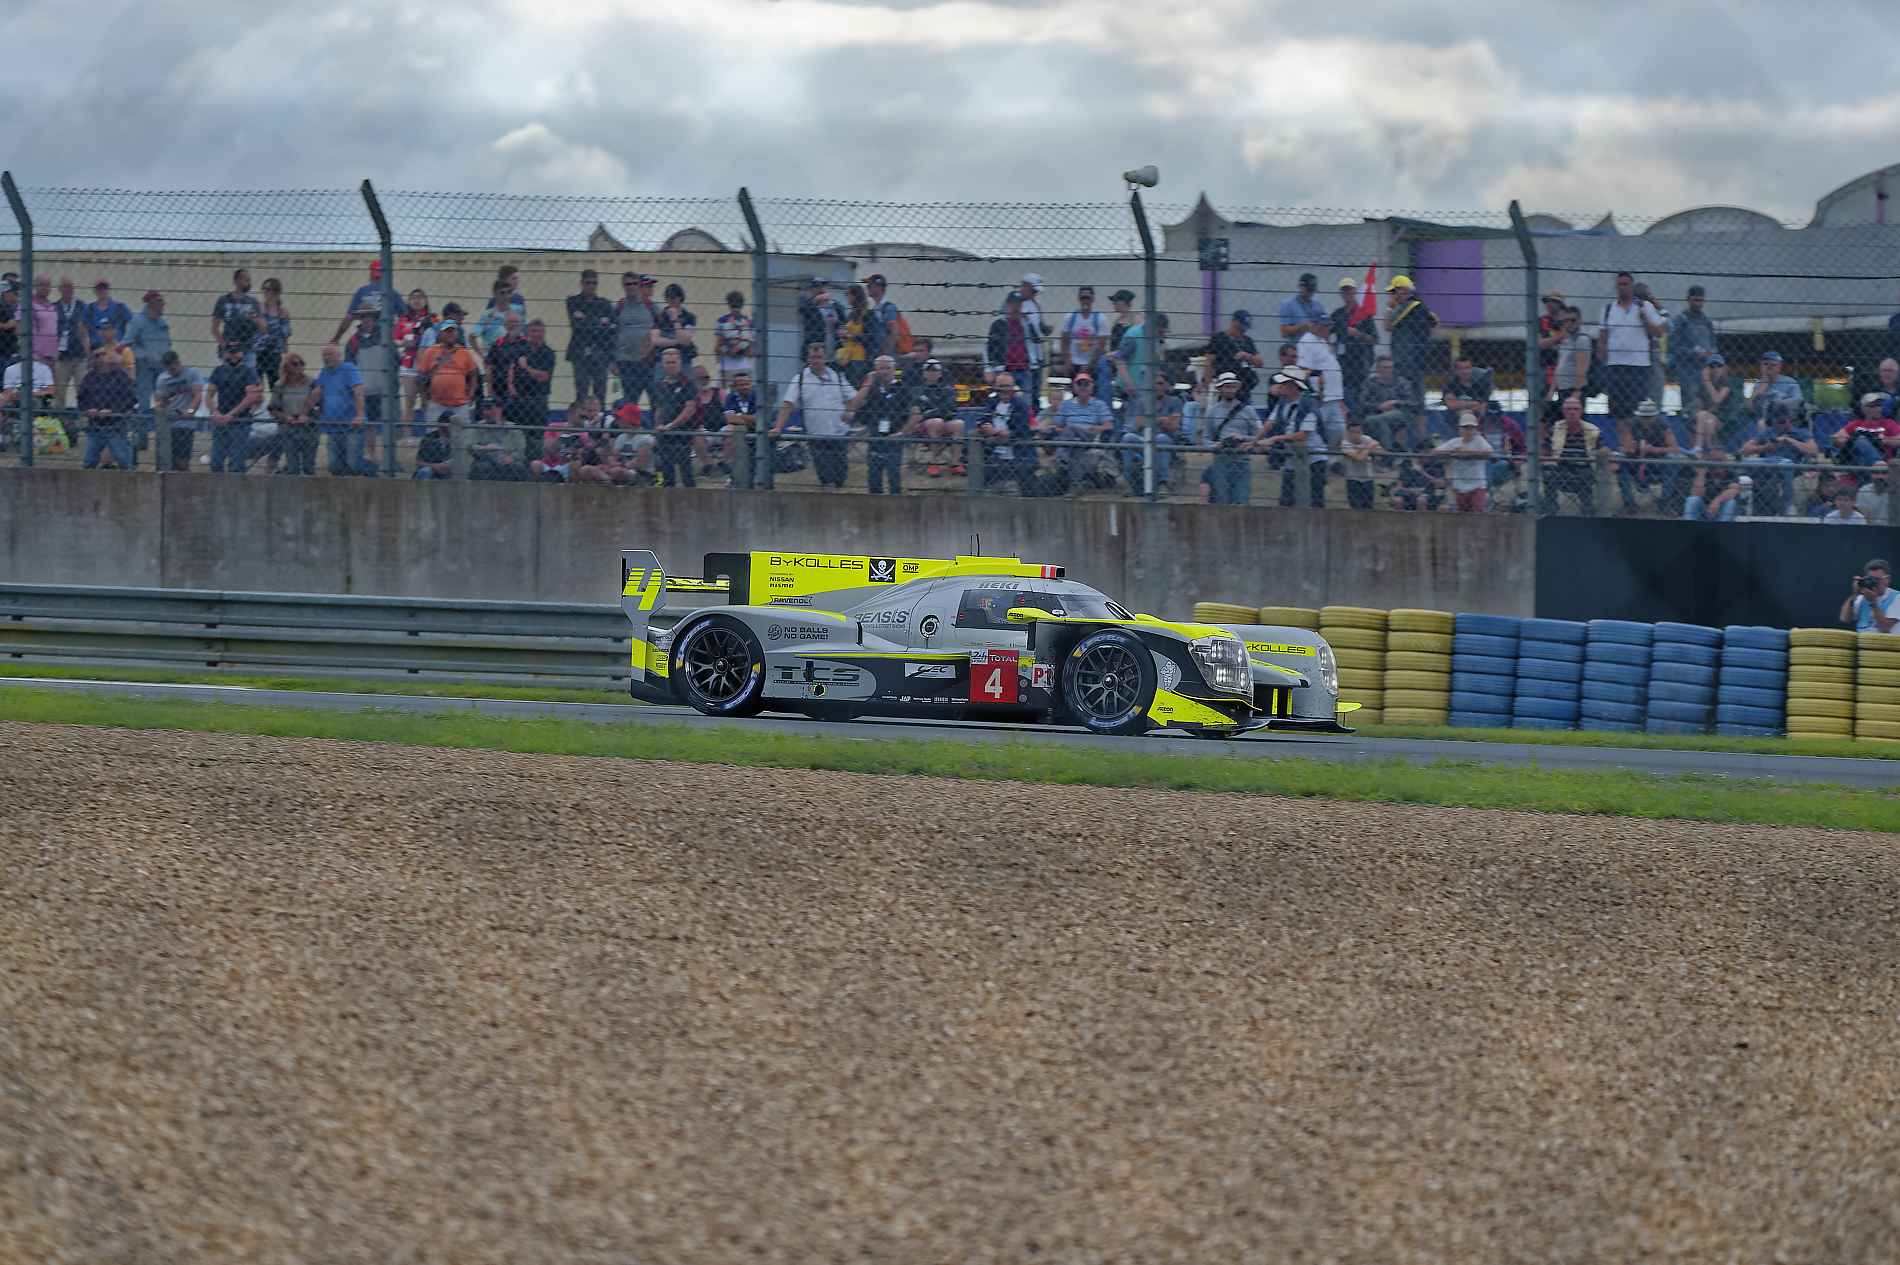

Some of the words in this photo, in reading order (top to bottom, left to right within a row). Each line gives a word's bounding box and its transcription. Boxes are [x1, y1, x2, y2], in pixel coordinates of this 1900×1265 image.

[902, 564, 919, 572] OMP
[989, 654, 1017, 663] TOTAL
[984, 668, 1003, 699] 4
